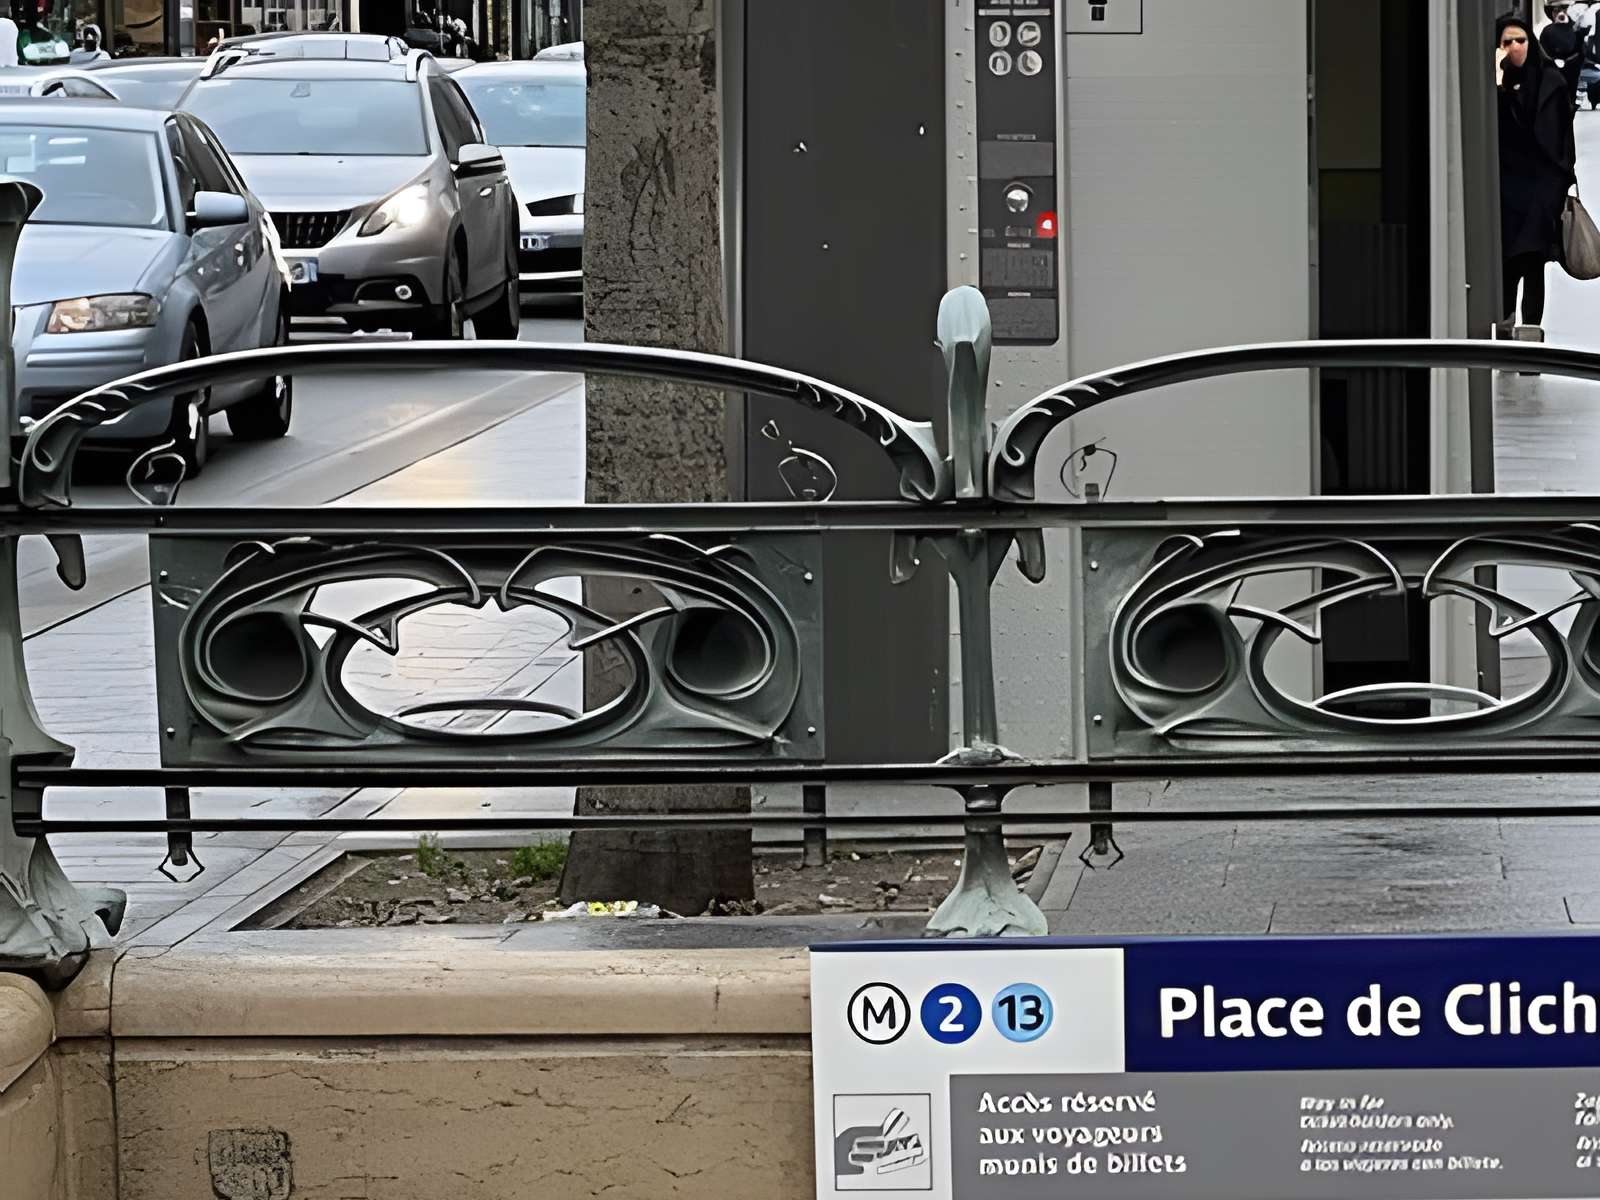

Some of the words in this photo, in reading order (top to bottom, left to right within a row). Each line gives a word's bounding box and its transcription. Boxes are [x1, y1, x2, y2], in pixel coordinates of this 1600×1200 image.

[862, 995, 896, 1031] M
[938, 995, 964, 1032] 2
[998, 994, 1045, 1031] 13
[1160, 983, 1325, 1039] Place
[1346, 983, 1421, 1037] de
[978, 1091, 1053, 1114] Accès
[979, 1127, 1025, 1145] aux
[1066, 1151, 1098, 1175] de
[1107, 1150, 1187, 1174] billets
